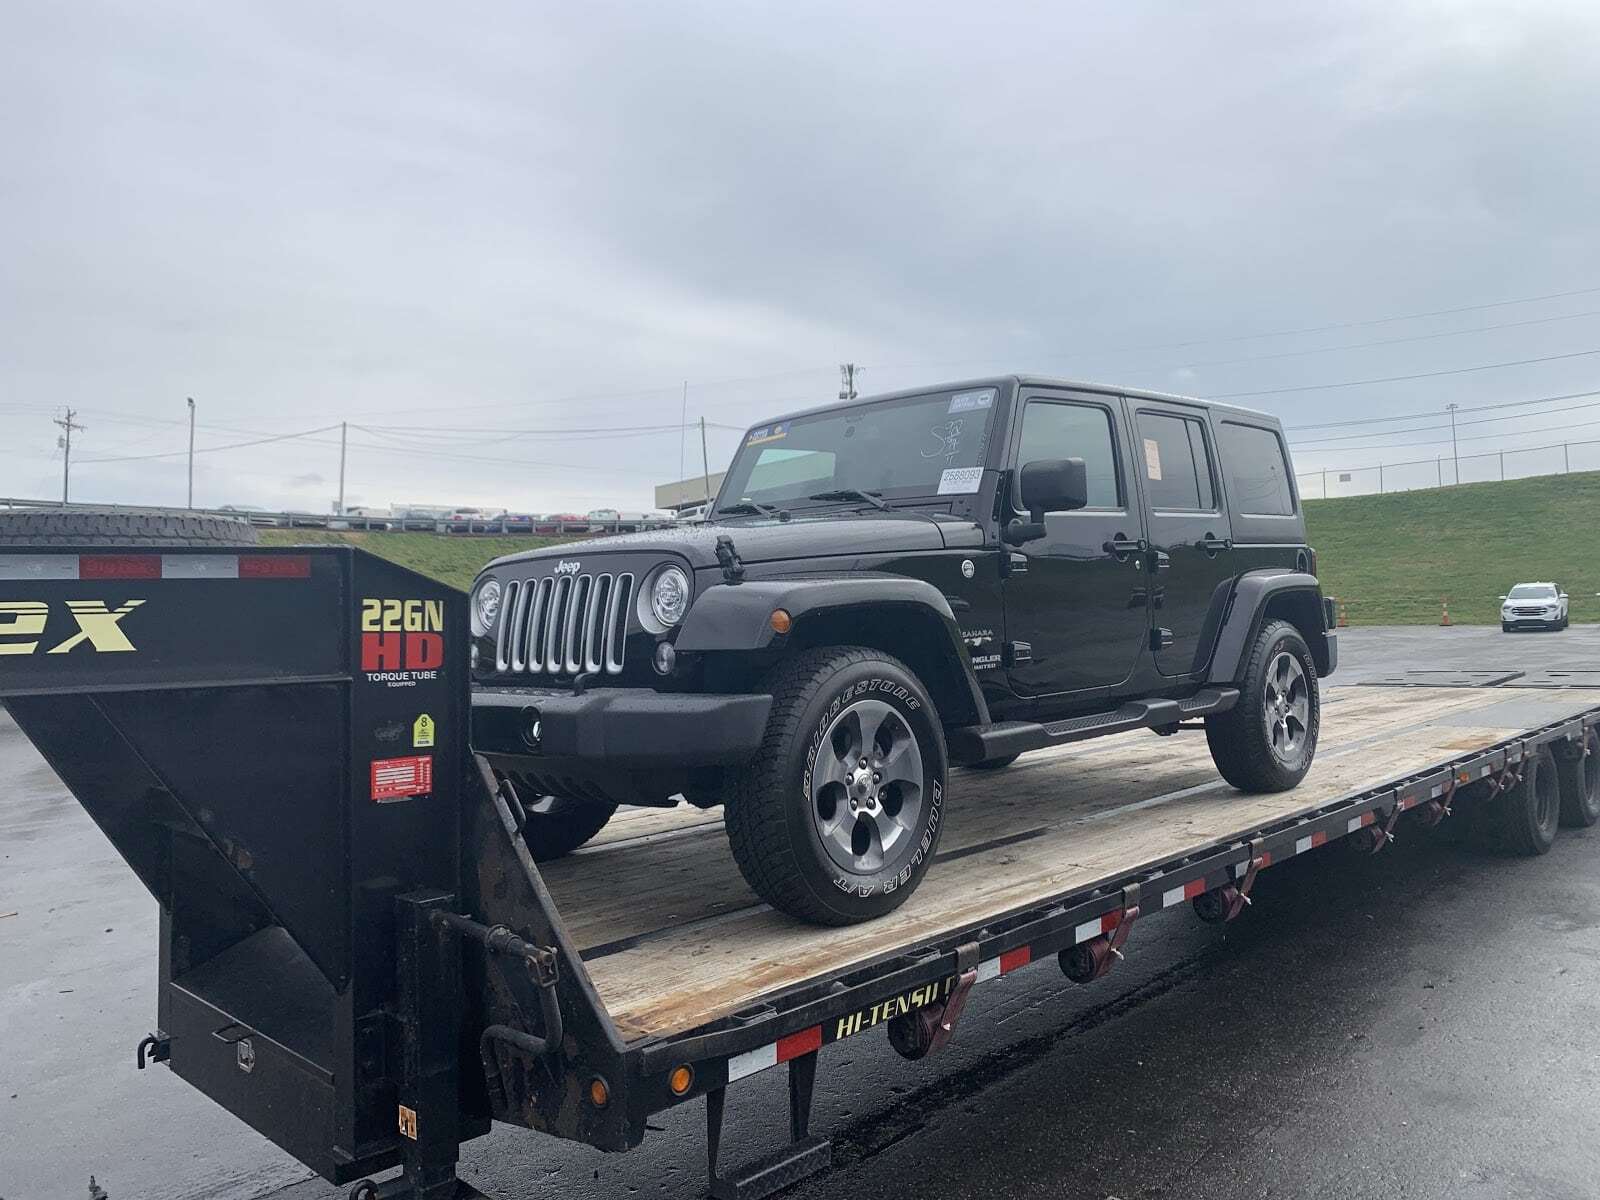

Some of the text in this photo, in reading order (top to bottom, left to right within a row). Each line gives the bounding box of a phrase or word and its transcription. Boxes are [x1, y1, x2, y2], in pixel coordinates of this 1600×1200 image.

[554, 560, 580, 575] Jeep
[362, 598, 444, 632] 22GN
[962, 629, 994, 638] SAHARA
[361, 632, 443, 671] HD
[972, 654, 1001, 664] NGLER
[367, 671, 437, 682] TORQUE TUBE
[420, 716, 428, 728] 8
[802, 679, 921, 801] BRIDGESTONE
[883, 780, 943, 895] DUELER
